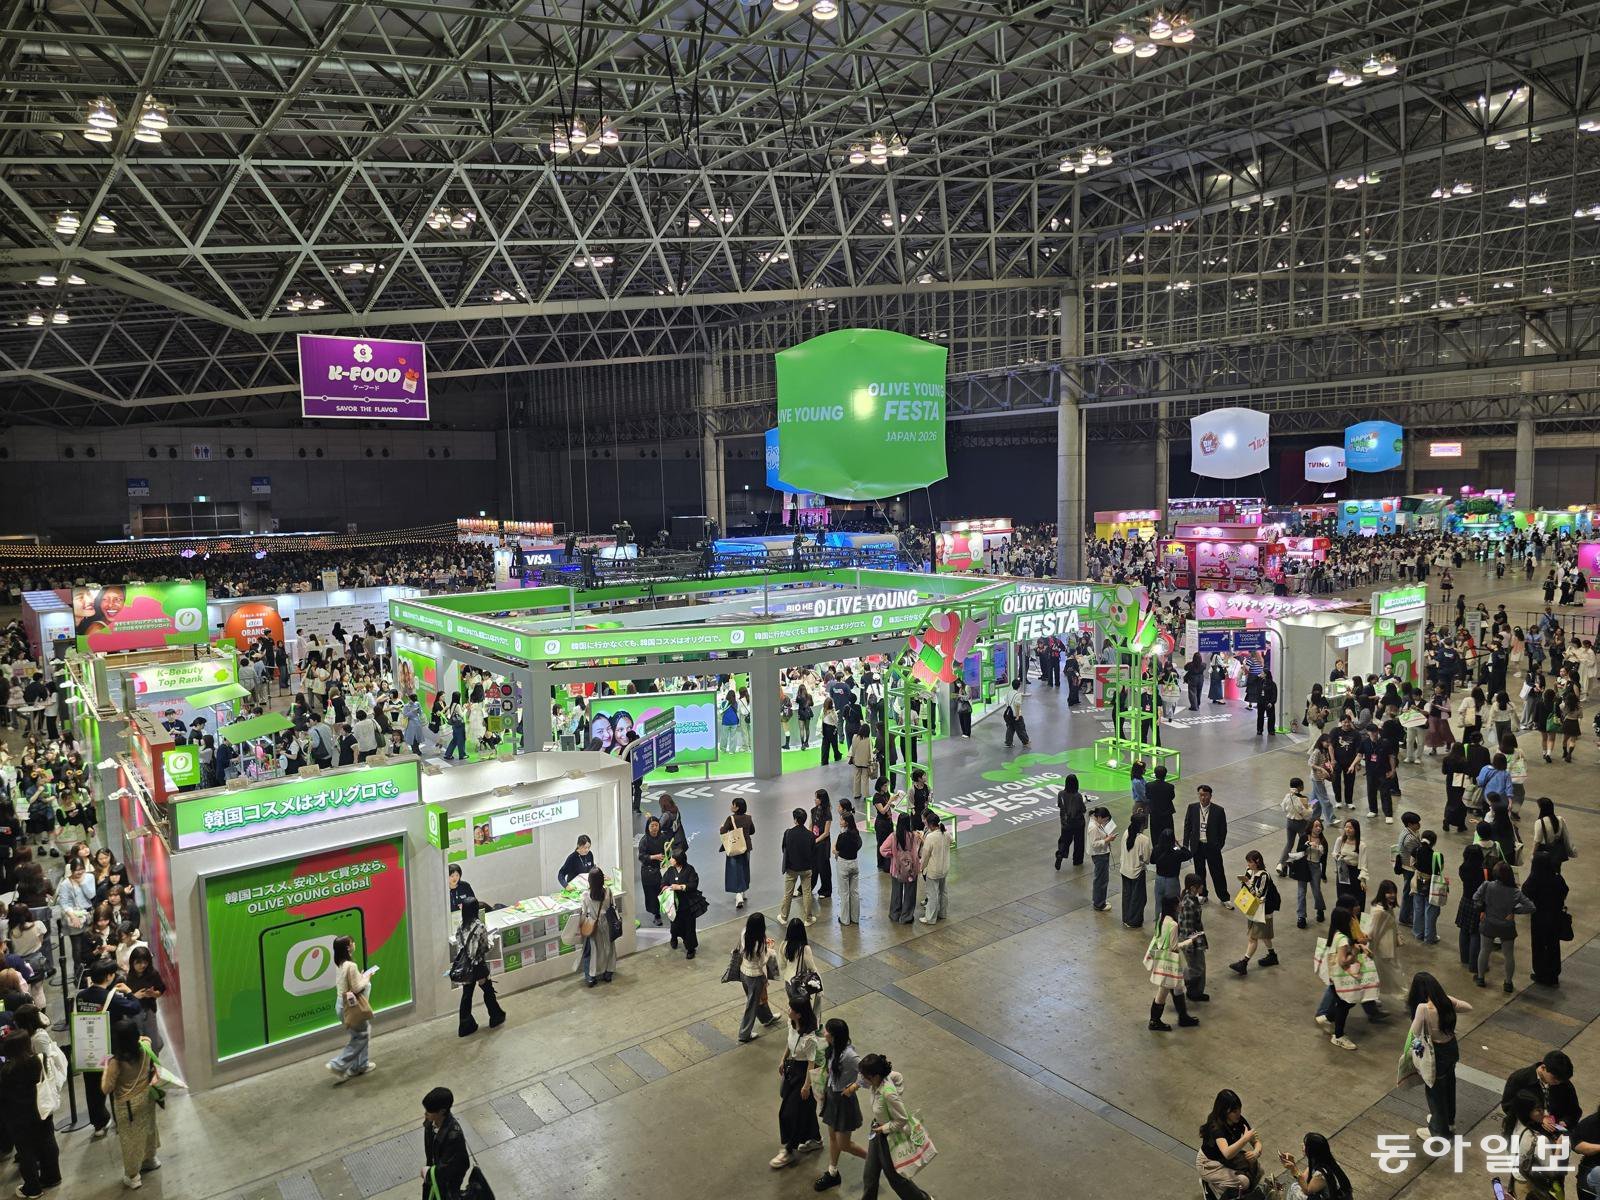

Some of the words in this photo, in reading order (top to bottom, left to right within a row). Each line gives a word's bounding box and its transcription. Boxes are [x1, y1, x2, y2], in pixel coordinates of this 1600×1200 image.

[328, 365, 401, 383] K-FOOD
[868, 382, 911, 397] OLIVE
[913, 382, 945, 398] YOUNG
[794, 405, 844, 422] YOUNG
[883, 400, 940, 421] FESTA
[885, 431, 917, 442] JAPAN
[918, 431, 938, 442] 2026
[524, 553, 552, 566] VISA
[813, 595, 862, 618] OLIVE
[866, 589, 918, 612] YOUNG
[1002, 593, 1045, 614] OLIVE
[1047, 587, 1092, 608] YOUNG
[241, 628, 268, 637] ORANG
[1016, 610, 1080, 641] FESTA
[157, 666, 204, 677] K-Beauty
[158, 678, 176, 687] Top
[179, 675, 203, 684] Rank
[987, 772, 1063, 794] YOUNG
[203, 780, 399, 829] 韓国コスメはオリグロで。
[968, 783, 1065, 816] FESTA
[509, 806, 563, 826] CHECK-IN
[224, 860, 387, 906] 韓国コスメ、安心して買うなら、
[247, 899, 285, 914] OLIVE
[286, 887, 330, 906] YOUNG
[332, 876, 371, 893] Global
[288, 1004, 332, 1022] DOWNLOAD
